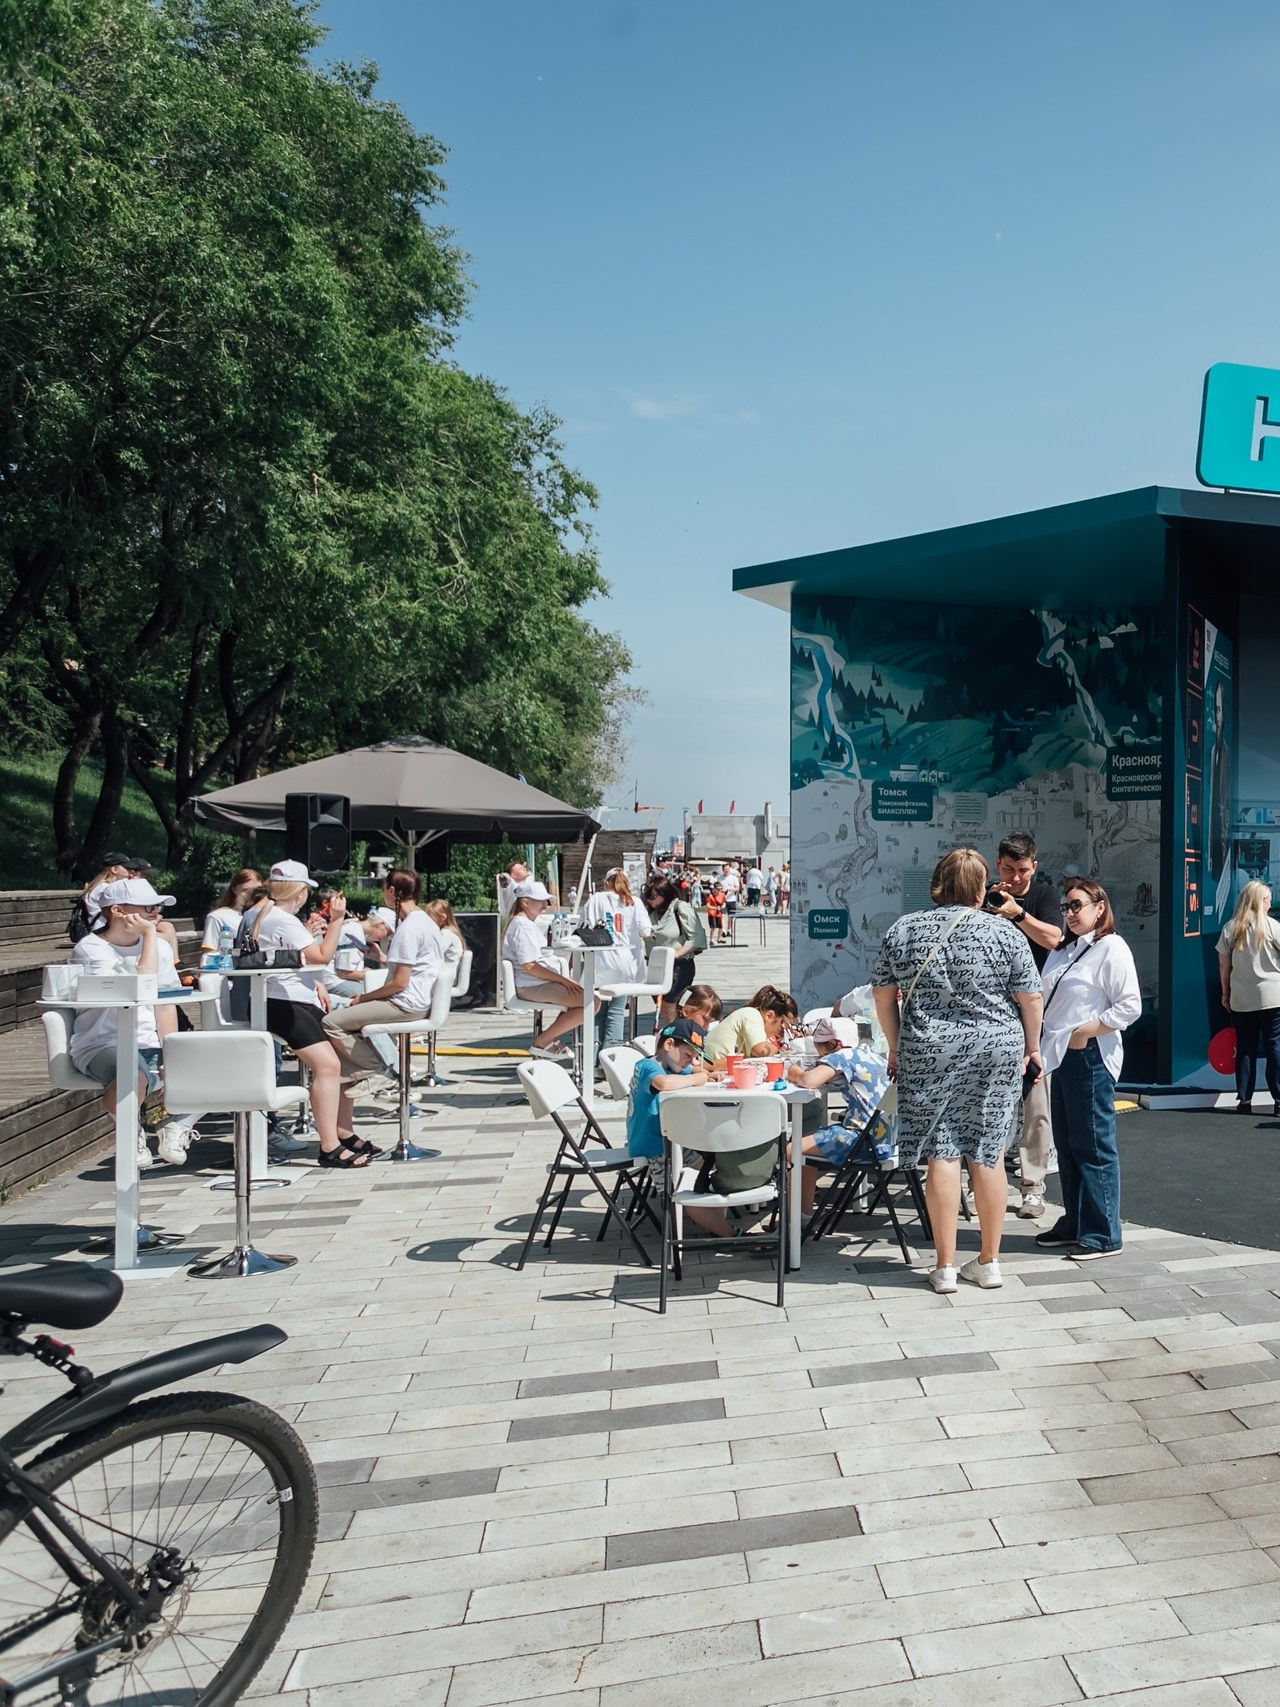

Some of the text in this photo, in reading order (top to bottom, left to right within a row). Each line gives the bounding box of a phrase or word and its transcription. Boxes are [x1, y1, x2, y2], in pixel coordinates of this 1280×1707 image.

[1111, 754, 1162, 770] Краснояр
[1111, 771, 1162, 785] Красноярский
[877, 787, 908, 797] Томск
[877, 807, 918, 815] БИАКСПЛЕН
[813, 914, 841, 924] Омск
